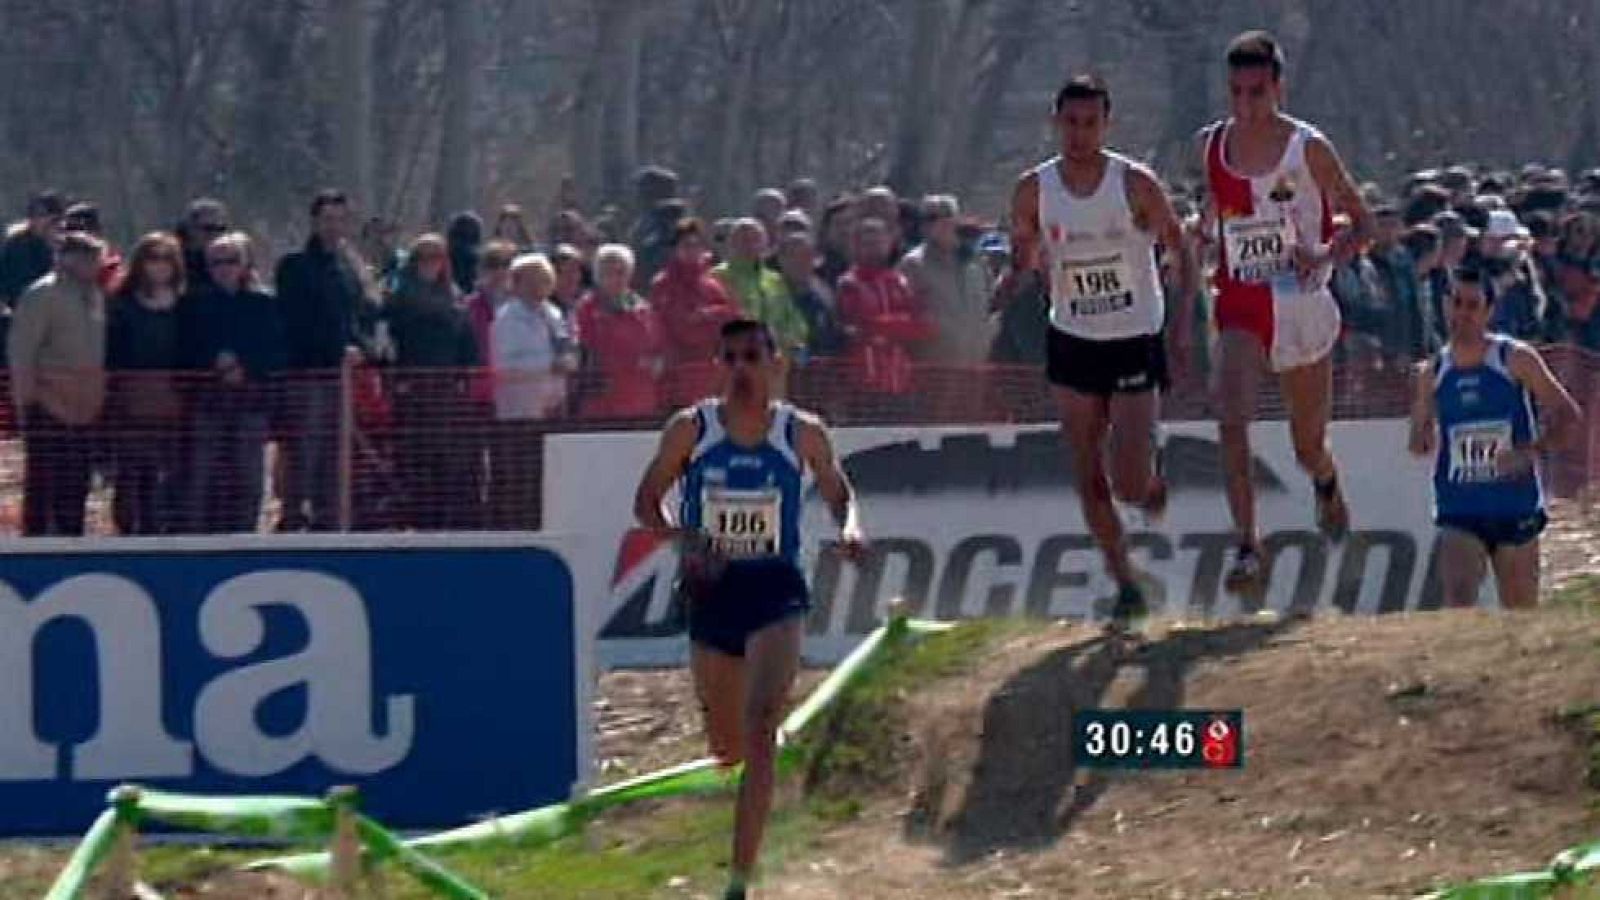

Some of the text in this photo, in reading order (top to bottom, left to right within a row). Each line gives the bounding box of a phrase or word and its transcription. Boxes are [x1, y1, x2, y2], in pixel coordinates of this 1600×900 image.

[1237, 233, 1282, 260] 200
[1073, 269, 1120, 296] 198
[717, 509, 766, 536] 186
